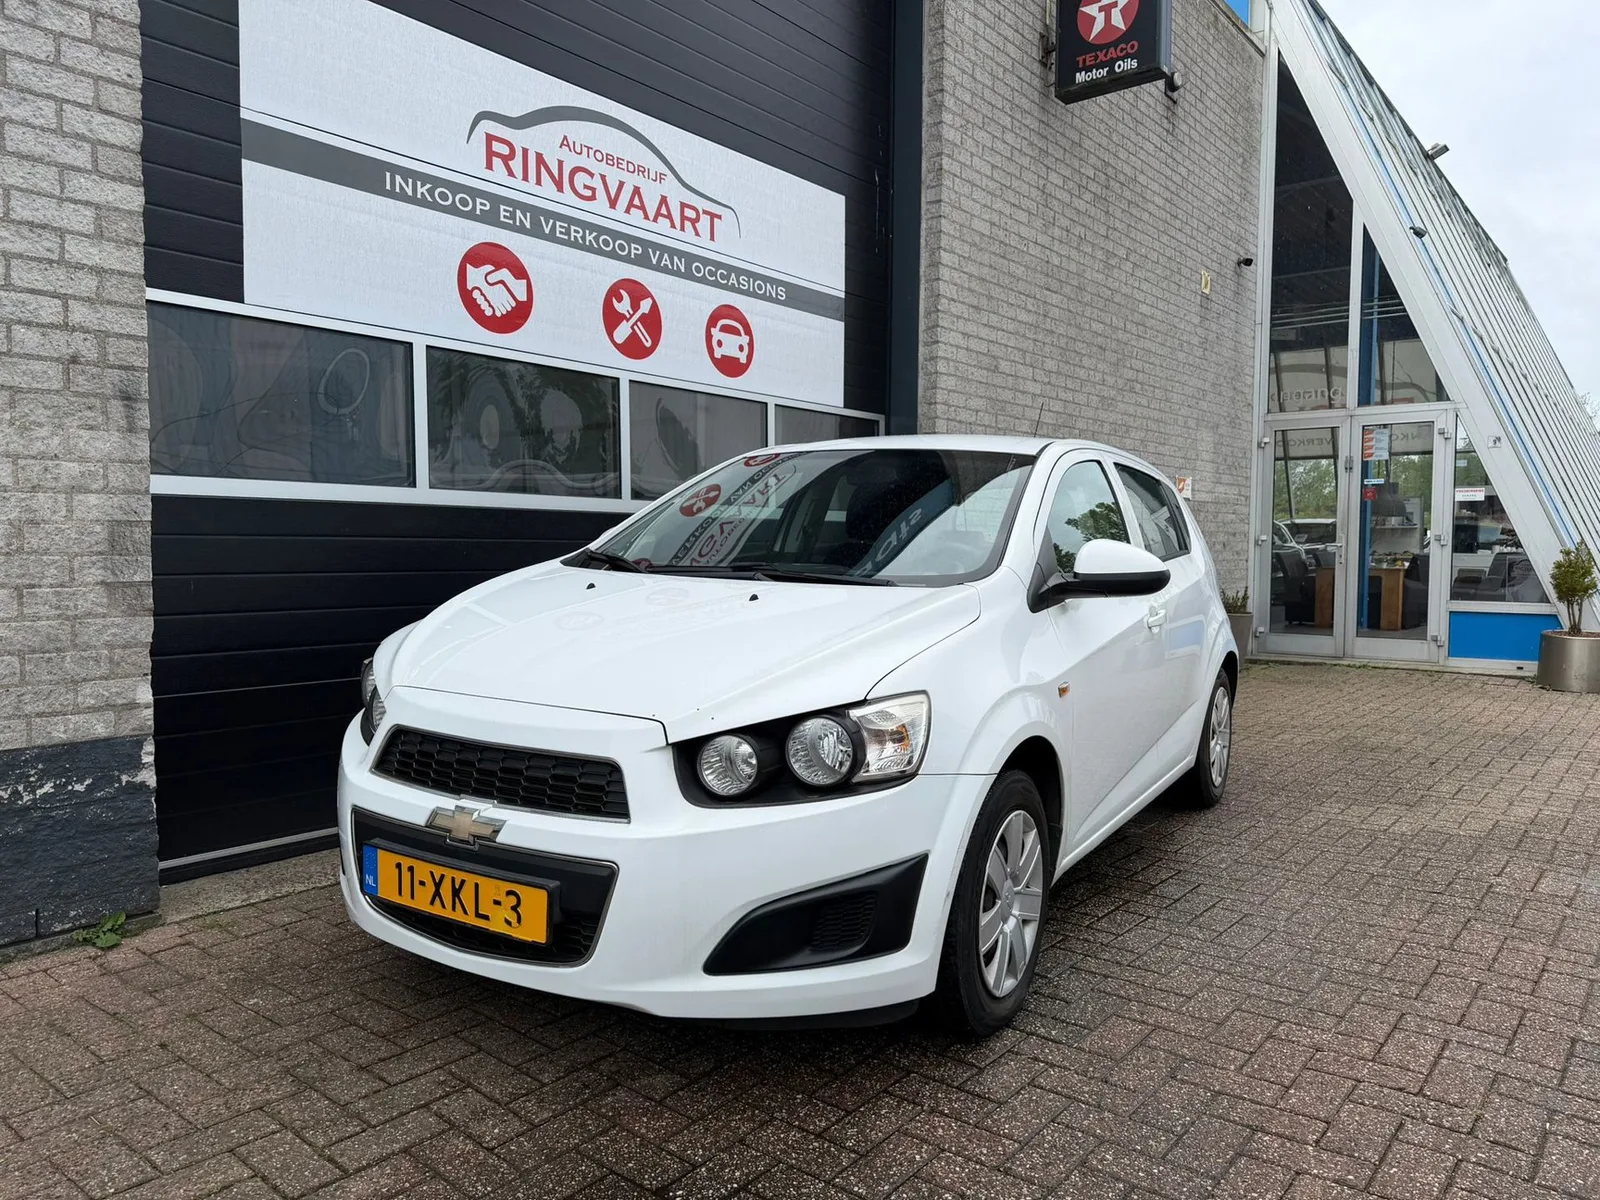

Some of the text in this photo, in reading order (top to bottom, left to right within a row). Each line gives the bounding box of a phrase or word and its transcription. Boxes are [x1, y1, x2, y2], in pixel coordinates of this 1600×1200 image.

[1075, 57, 1138, 84] Motor Oils
[1076, 40, 1139, 68] TEXACO
[559, 134, 668, 185] AUTOBEDRIJF
[484, 131, 722, 243] RINGVAART
[385, 171, 786, 301] INKOOP EN VERKOOP VAN OCCASIONS
[365, 873, 377, 887] NL
[394, 861, 523, 929] 11-XKL-3
